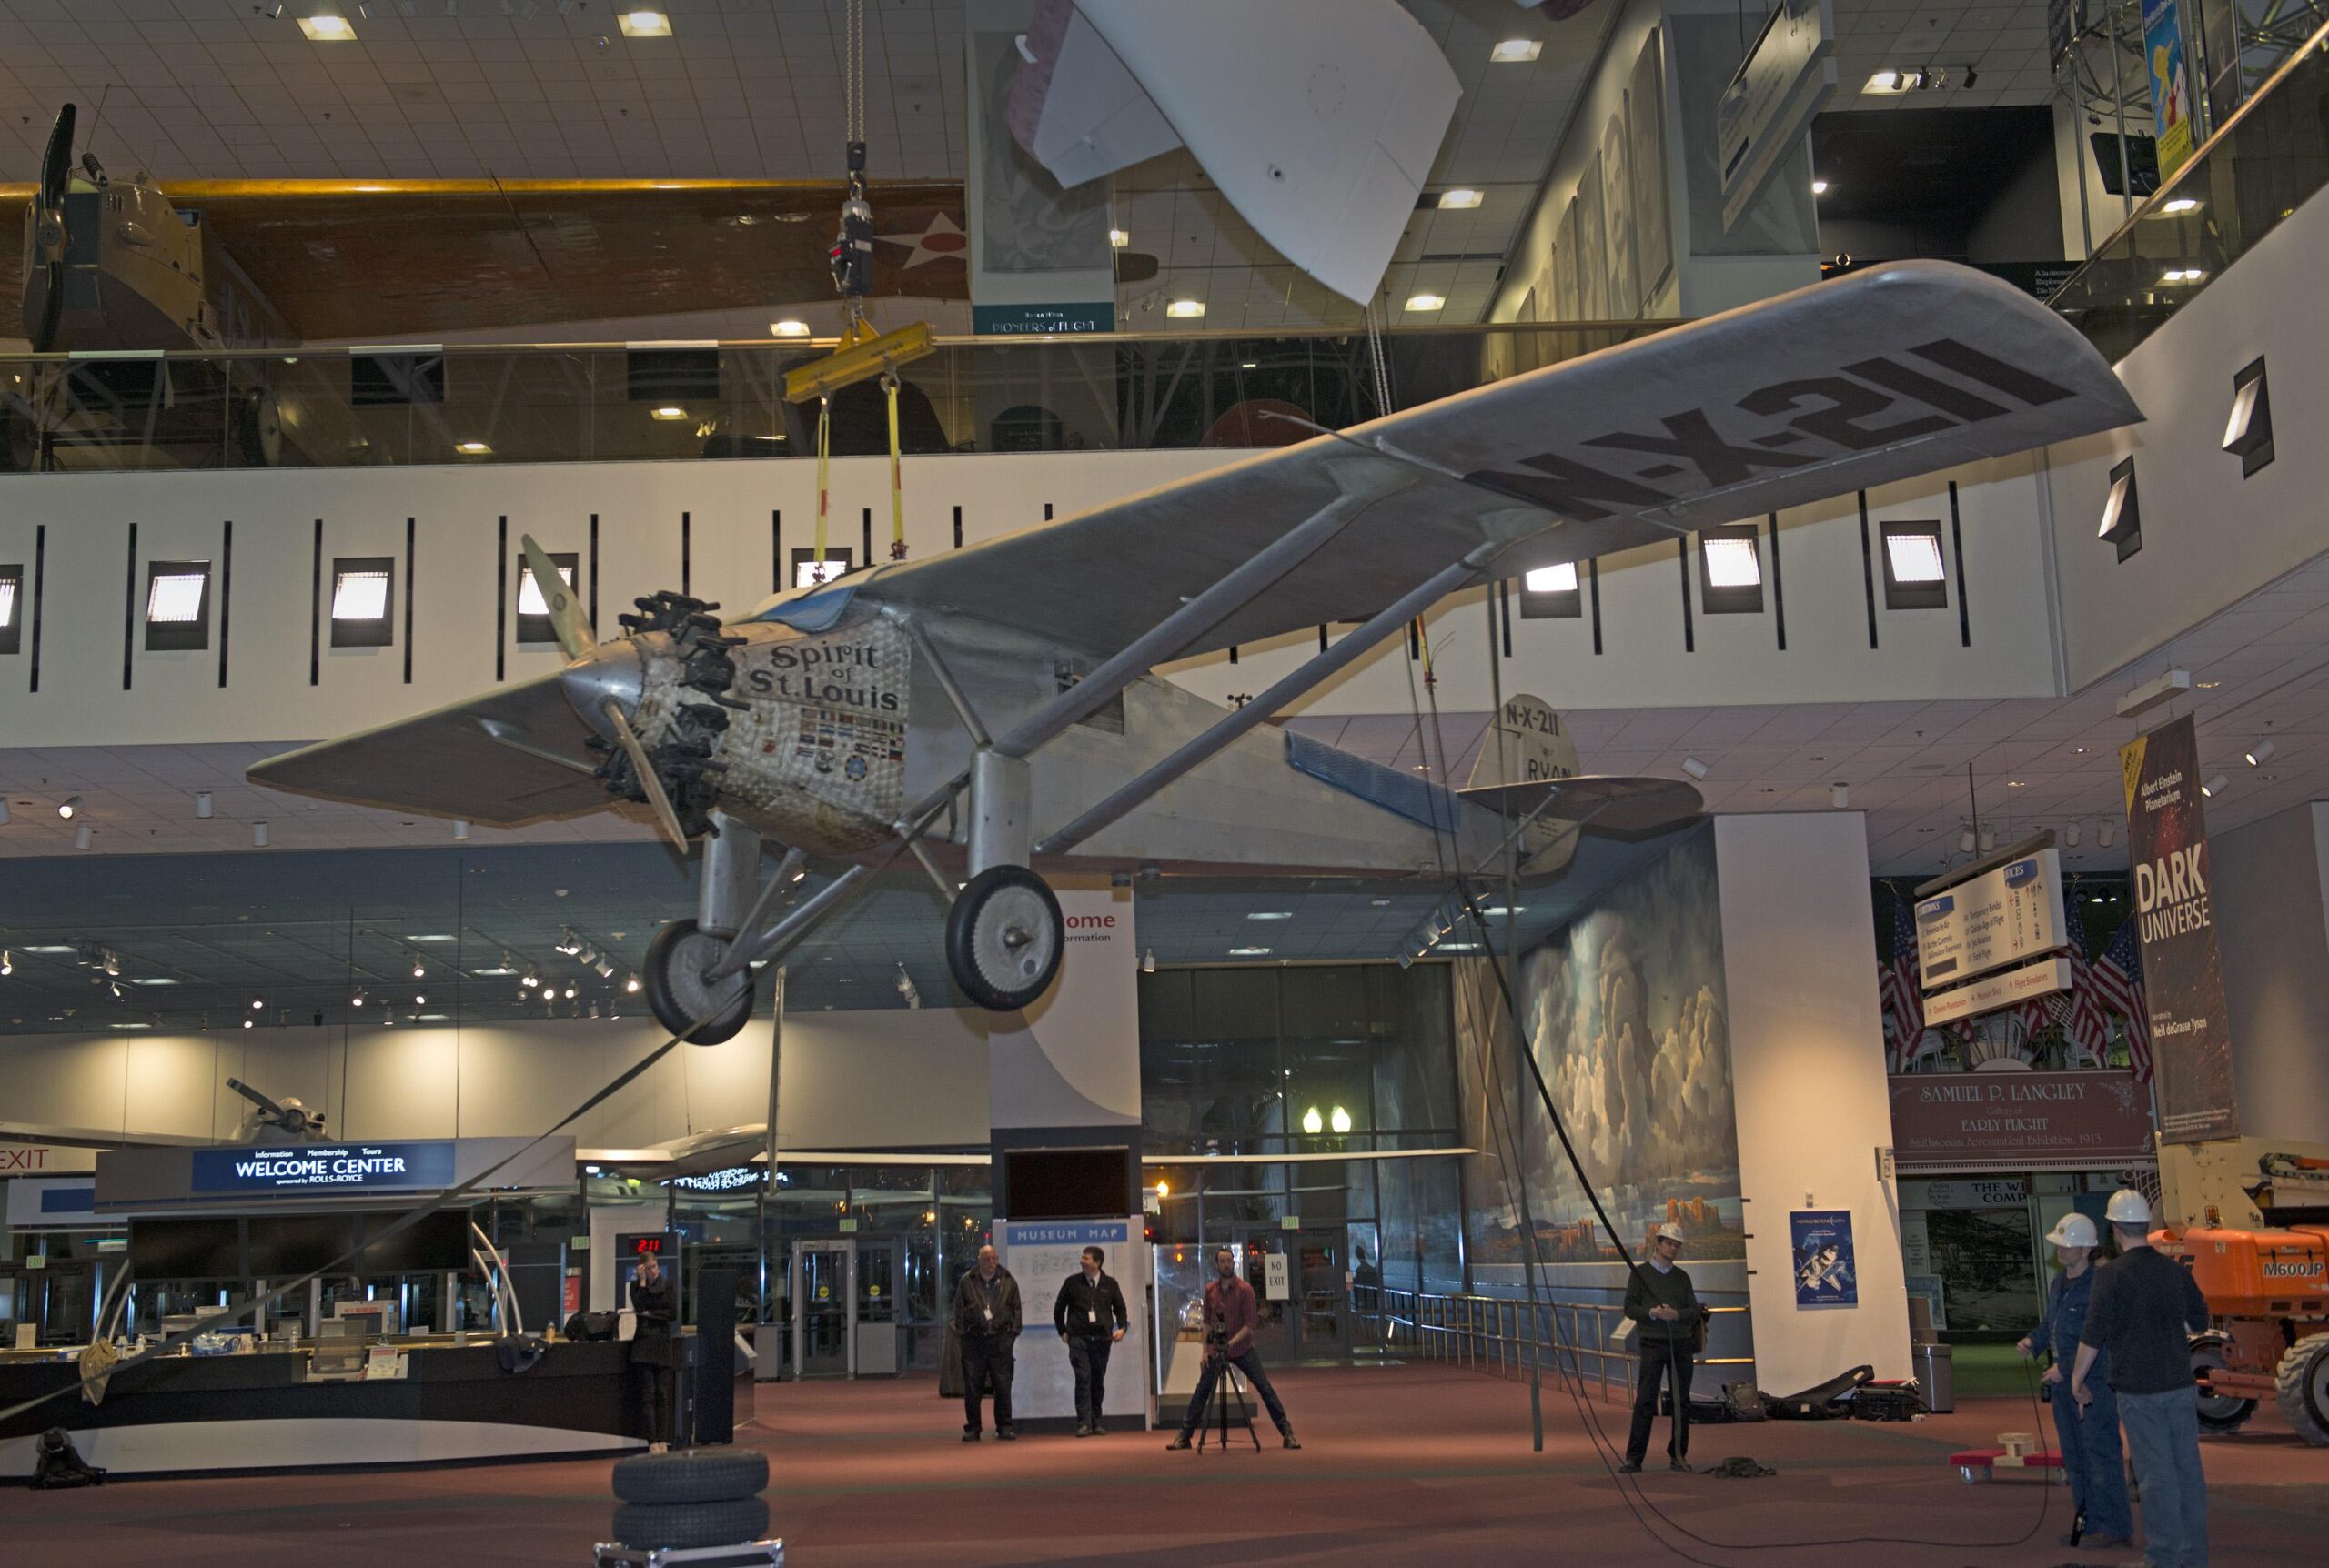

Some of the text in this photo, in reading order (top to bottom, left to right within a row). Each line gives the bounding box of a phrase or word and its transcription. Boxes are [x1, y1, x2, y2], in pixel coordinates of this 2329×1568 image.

[1059, 320, 1095, 331] FLIGHT
[771, 640, 879, 673] Spirit
[831, 666, 857, 684] of
[804, 676, 899, 711] Louis
[1507, 703, 1560, 737] N-X-211
[2141, 769, 2183, 799] Albert Einstein
[2145, 789, 2181, 813] Planetarium
[2136, 843, 2207, 913] DARK
[2142, 897, 2211, 944] UNIVERSE
[2153, 1018, 2207, 1038] Neil deGrasse Tyson
[1920, 1083, 2087, 1102] SAMUEL P. LANGLEY
[1961, 1117, 2048, 1131] EARLY FLIGHT
[1908, 1134, 1964, 1148] Smithsonian
[1966, 1135, 2024, 1147] Aeronautical
[2079, 1133, 2102, 1144] 1913
[236, 1157, 406, 1178] WELCOME CENTER
[309, 1174, 363, 1183] ROLLS-ROYCE
[1971, 1182, 2025, 1192] THE W
[1982, 1193, 2027, 1203] COMP
[1017, 1228, 1118, 1241] MUSEUM MAP
[1271, 1261, 1282, 1271] NO
[2263, 1262, 2324, 1277] M600JP
[1270, 1276, 1285, 1286] EXIT
